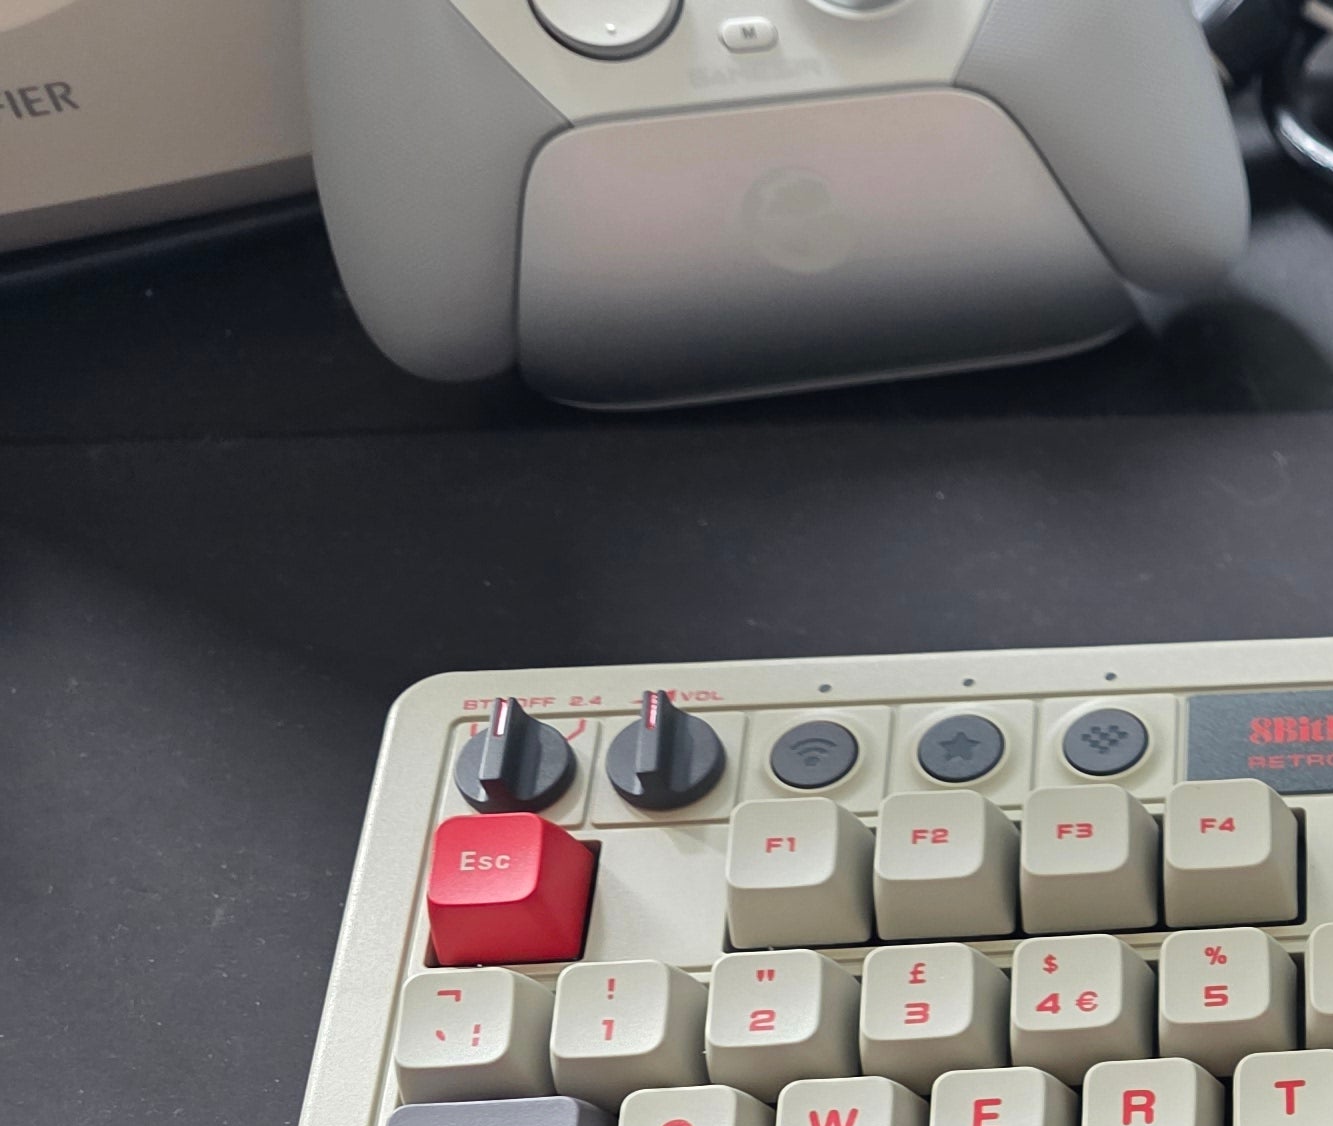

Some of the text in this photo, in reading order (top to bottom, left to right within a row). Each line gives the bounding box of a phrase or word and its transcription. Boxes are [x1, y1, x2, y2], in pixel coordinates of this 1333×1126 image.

[739, 25, 758, 40] M
[0, 81, 80, 120] IER
[569, 696, 602, 707] 2.4
[681, 690, 724, 702] VOL
[910, 827, 950, 845] F2
[1056, 821, 1094, 840] F3
[1199, 816, 1236, 833] F4
[764, 836, 797, 853] F1
[459, 850, 512, 873] Esc
[1043, 954, 1058, 974] $
[1204, 946, 1228, 965] %
[909, 961, 926, 985] £
[606, 976, 617, 999] !
[1202, 984, 1229, 1008] 5
[905, 1001, 931, 1025] 3
[1035, 990, 1097, 1014] 4 €
[601, 1018, 615, 1041] 1
[748, 1008, 777, 1033] 2
[1121, 1089, 1156, 1126] R
[1274, 1079, 1305, 1115] T
